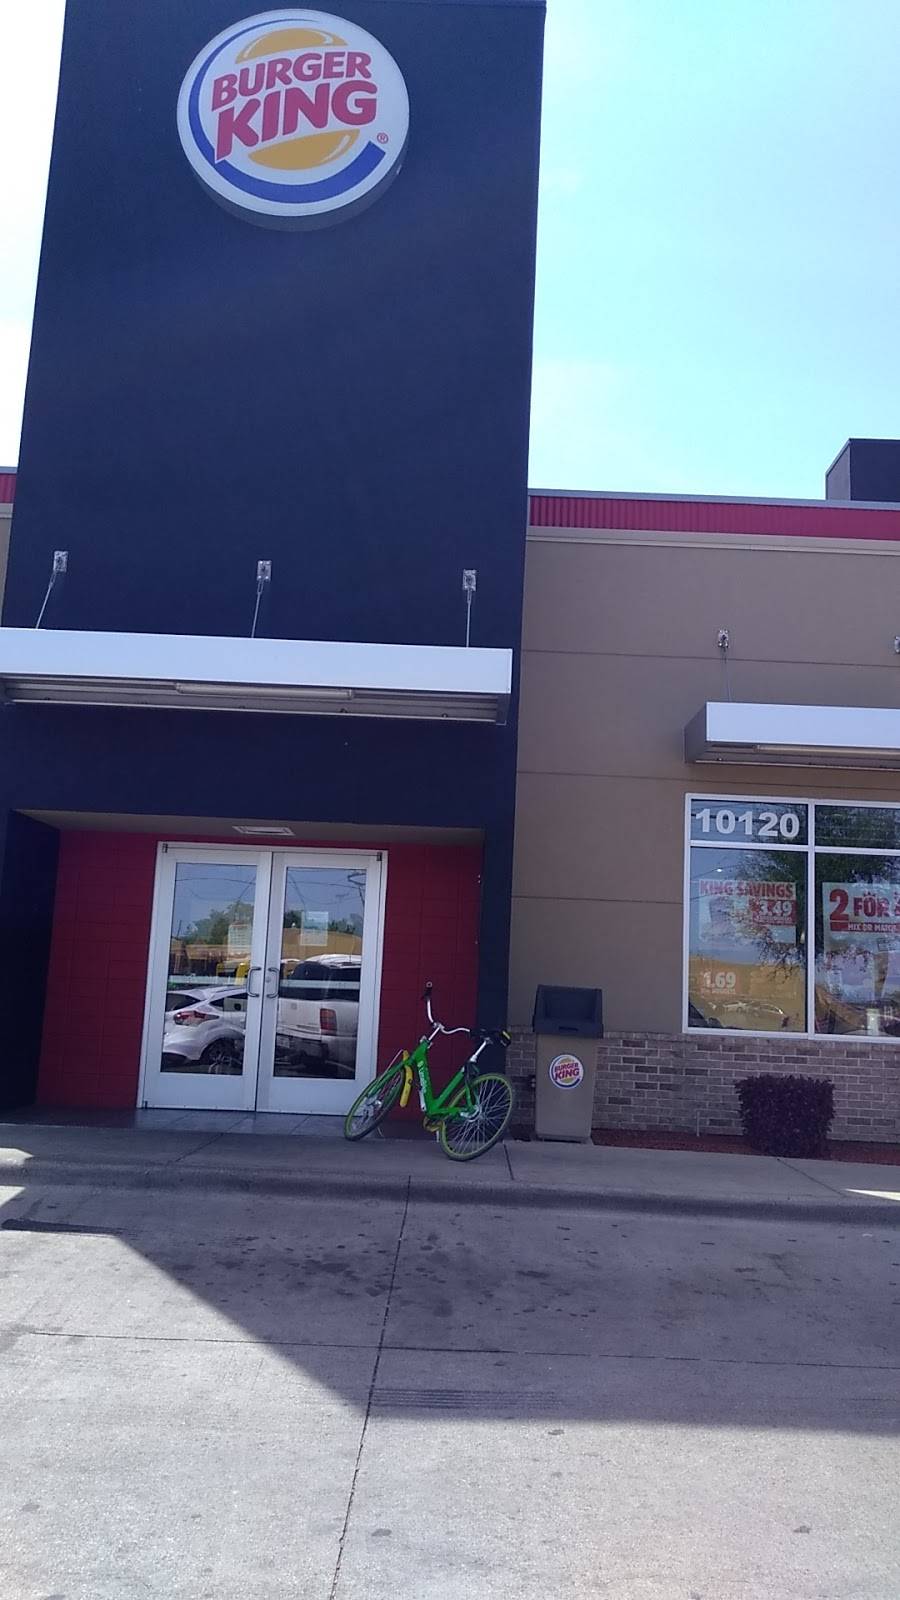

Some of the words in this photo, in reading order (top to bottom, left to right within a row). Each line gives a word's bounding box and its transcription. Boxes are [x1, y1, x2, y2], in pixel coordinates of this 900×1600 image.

[211, 51, 372, 112] BURGER
[216, 80, 378, 161] KING
[695, 808, 800, 838] 10120
[700, 880, 733, 896] KING
[735, 881, 794, 898] SAVINGS
[829, 888, 849, 921] 2
[853, 895, 890, 917] FOR
[554, 1062, 579, 1071] BURGER
[555, 1068, 580, 1080] KING
